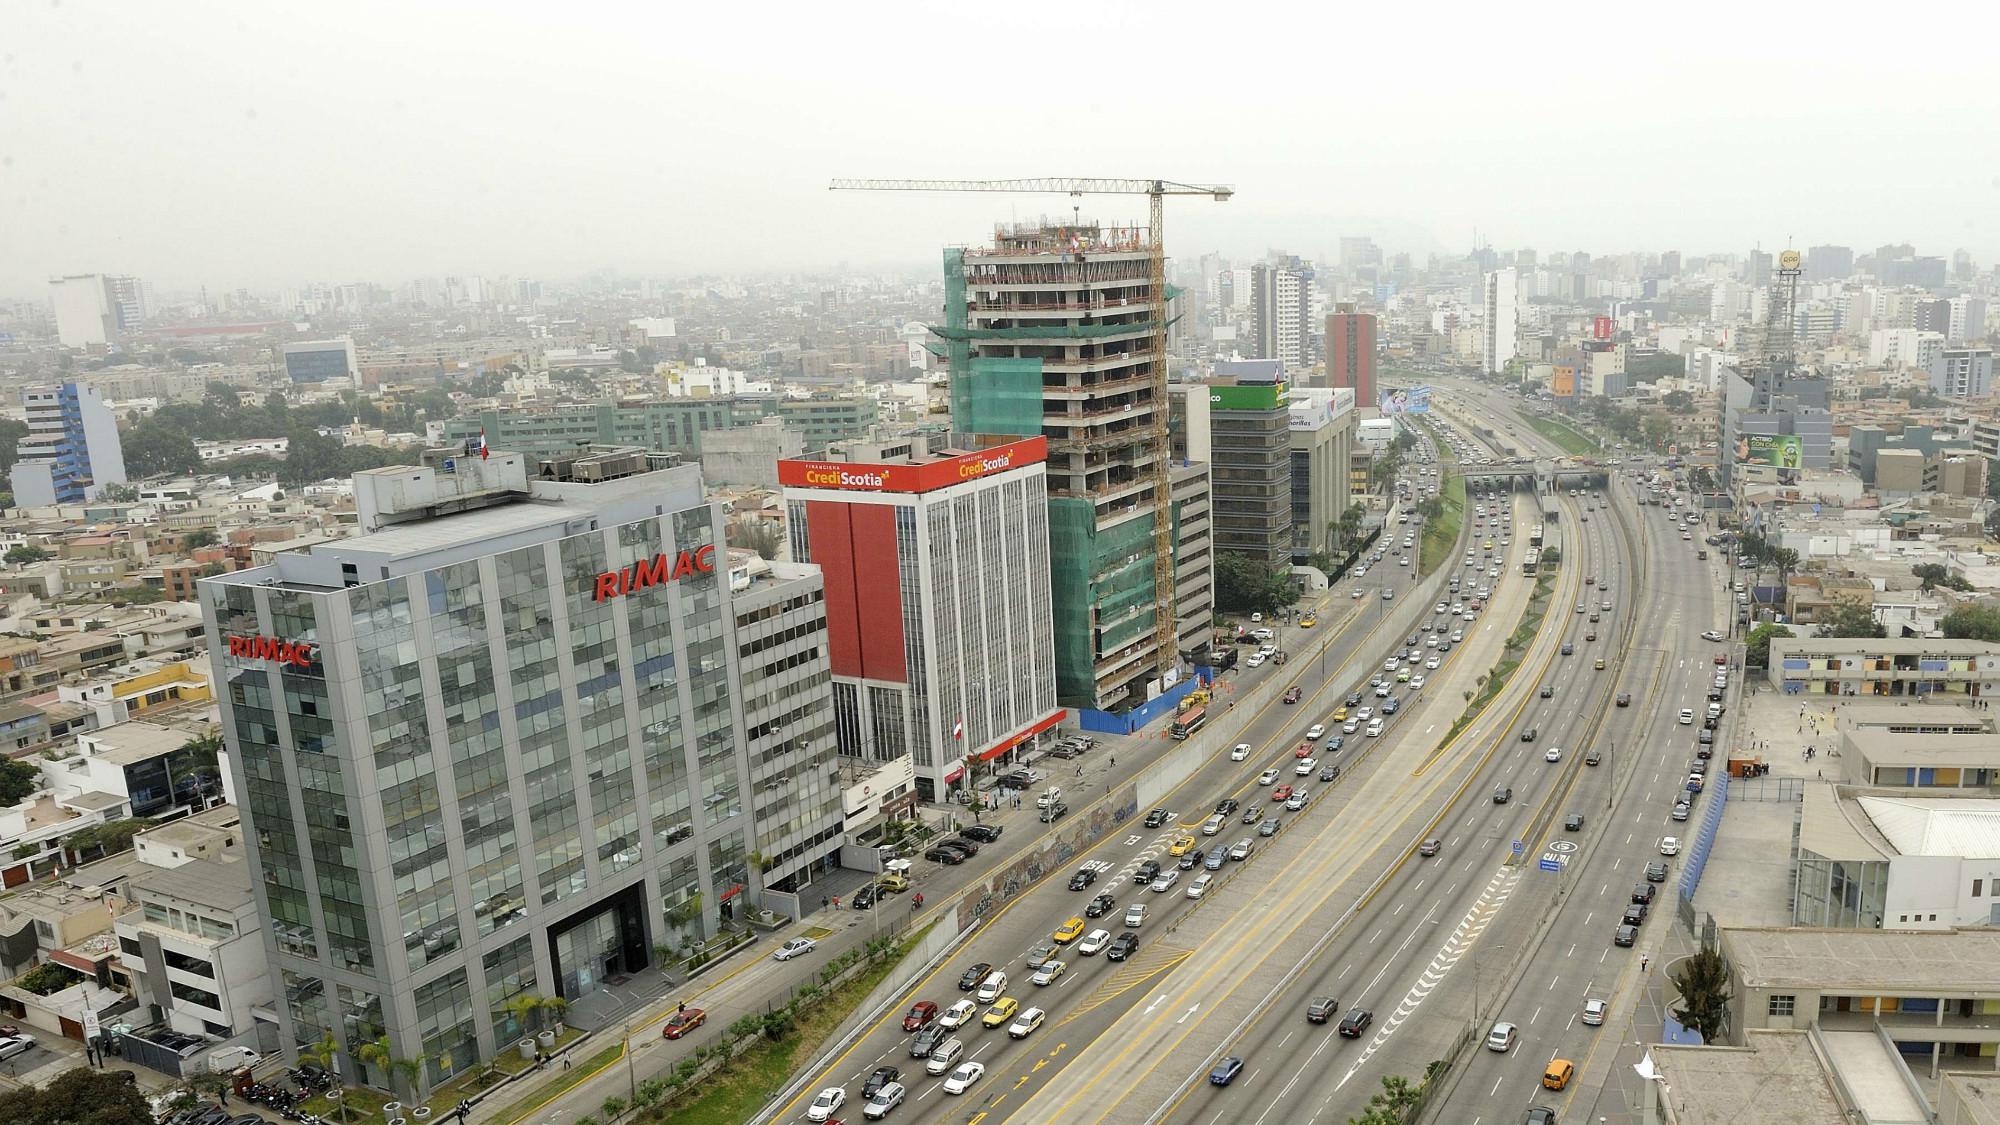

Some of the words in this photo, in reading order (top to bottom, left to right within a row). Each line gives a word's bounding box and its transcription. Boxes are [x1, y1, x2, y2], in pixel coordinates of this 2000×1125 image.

[806, 470, 883, 487] CrediScotia
[959, 454, 1010, 478] CrediScotia
[595, 543, 716, 604] RIMAC
[229, 634, 312, 667] RIMAC
